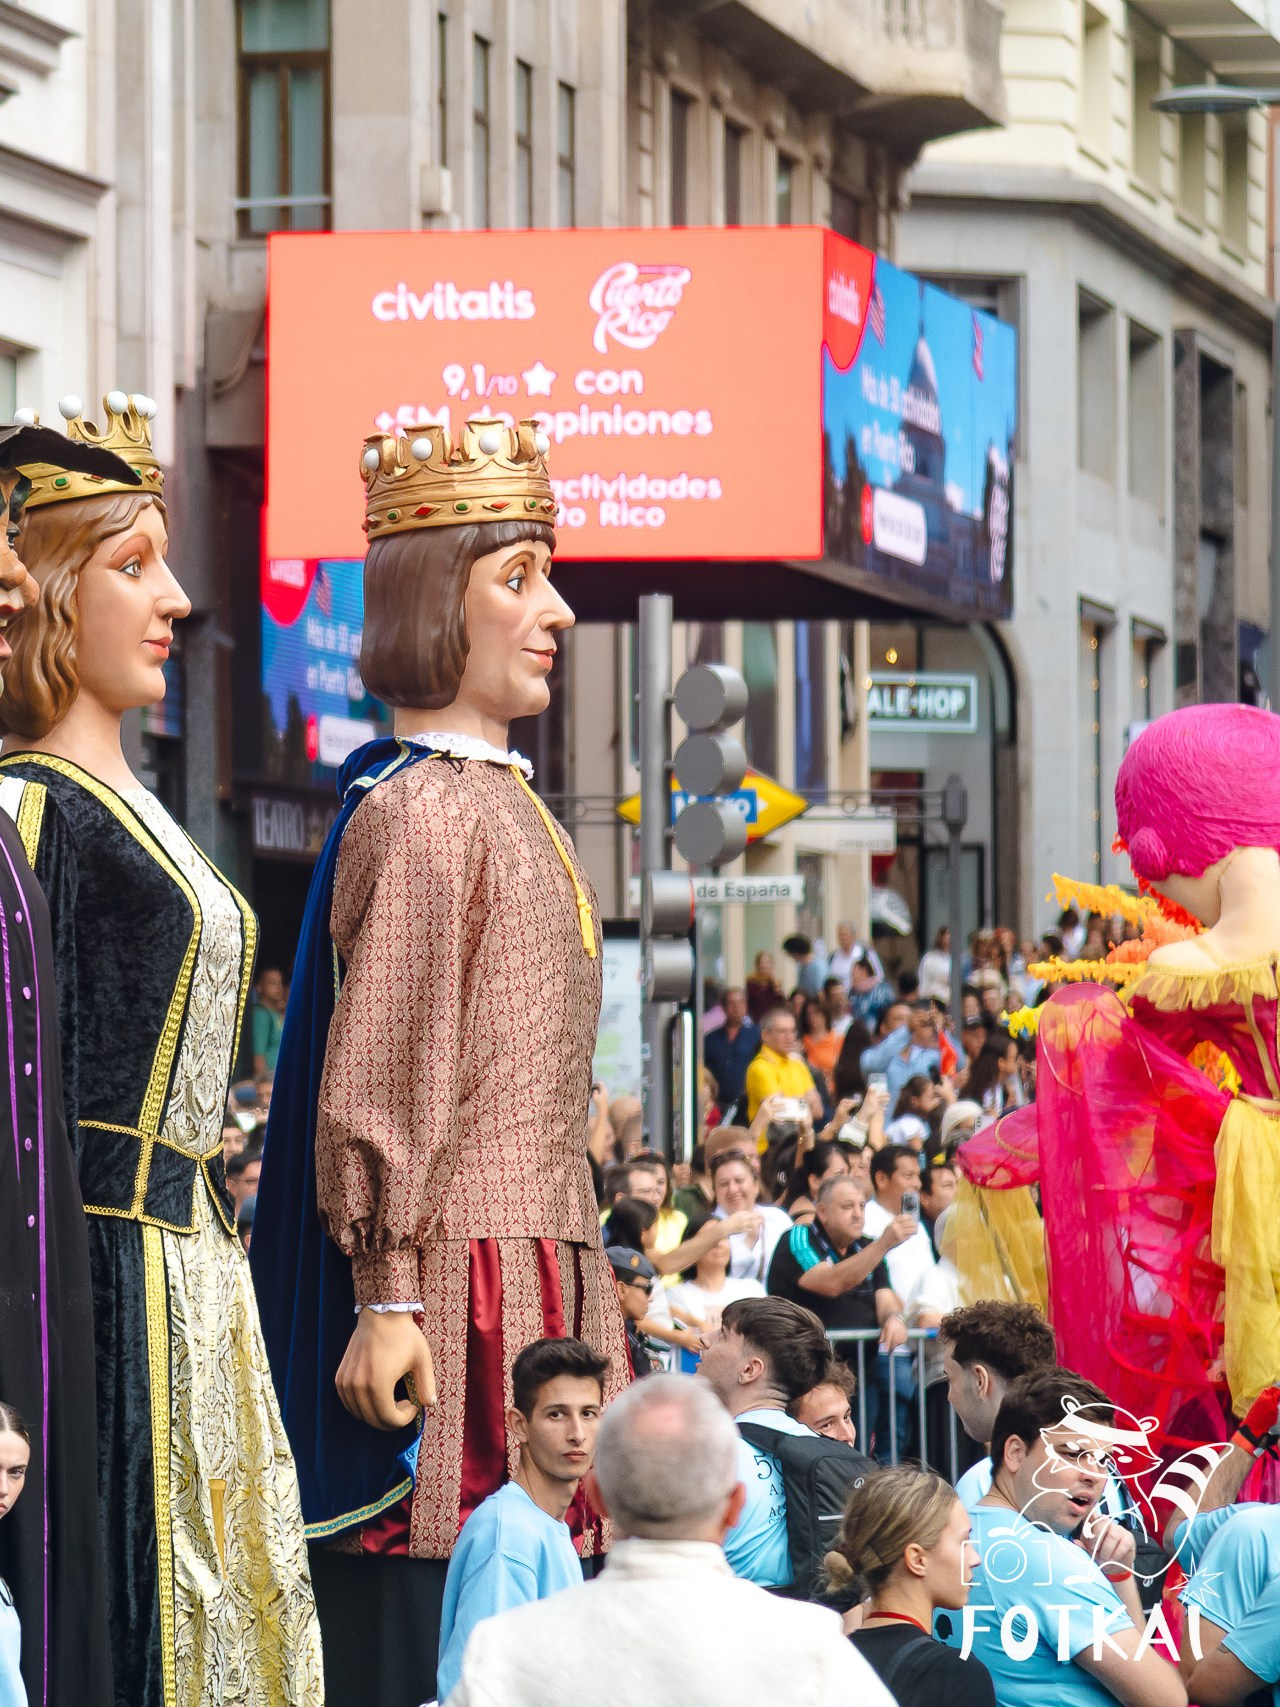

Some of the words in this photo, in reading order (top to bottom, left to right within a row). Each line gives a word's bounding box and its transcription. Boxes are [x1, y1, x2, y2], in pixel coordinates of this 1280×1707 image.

[372, 280, 535, 321] civitatis
[592, 307, 676, 355] Rico
[574, 369, 643, 395] con
[531, 403, 713, 444] opiniones
[550, 472, 722, 500] actividades
[599, 500, 666, 528] Rico
[696, 881, 719, 898] de
[724, 880, 791, 902] España
